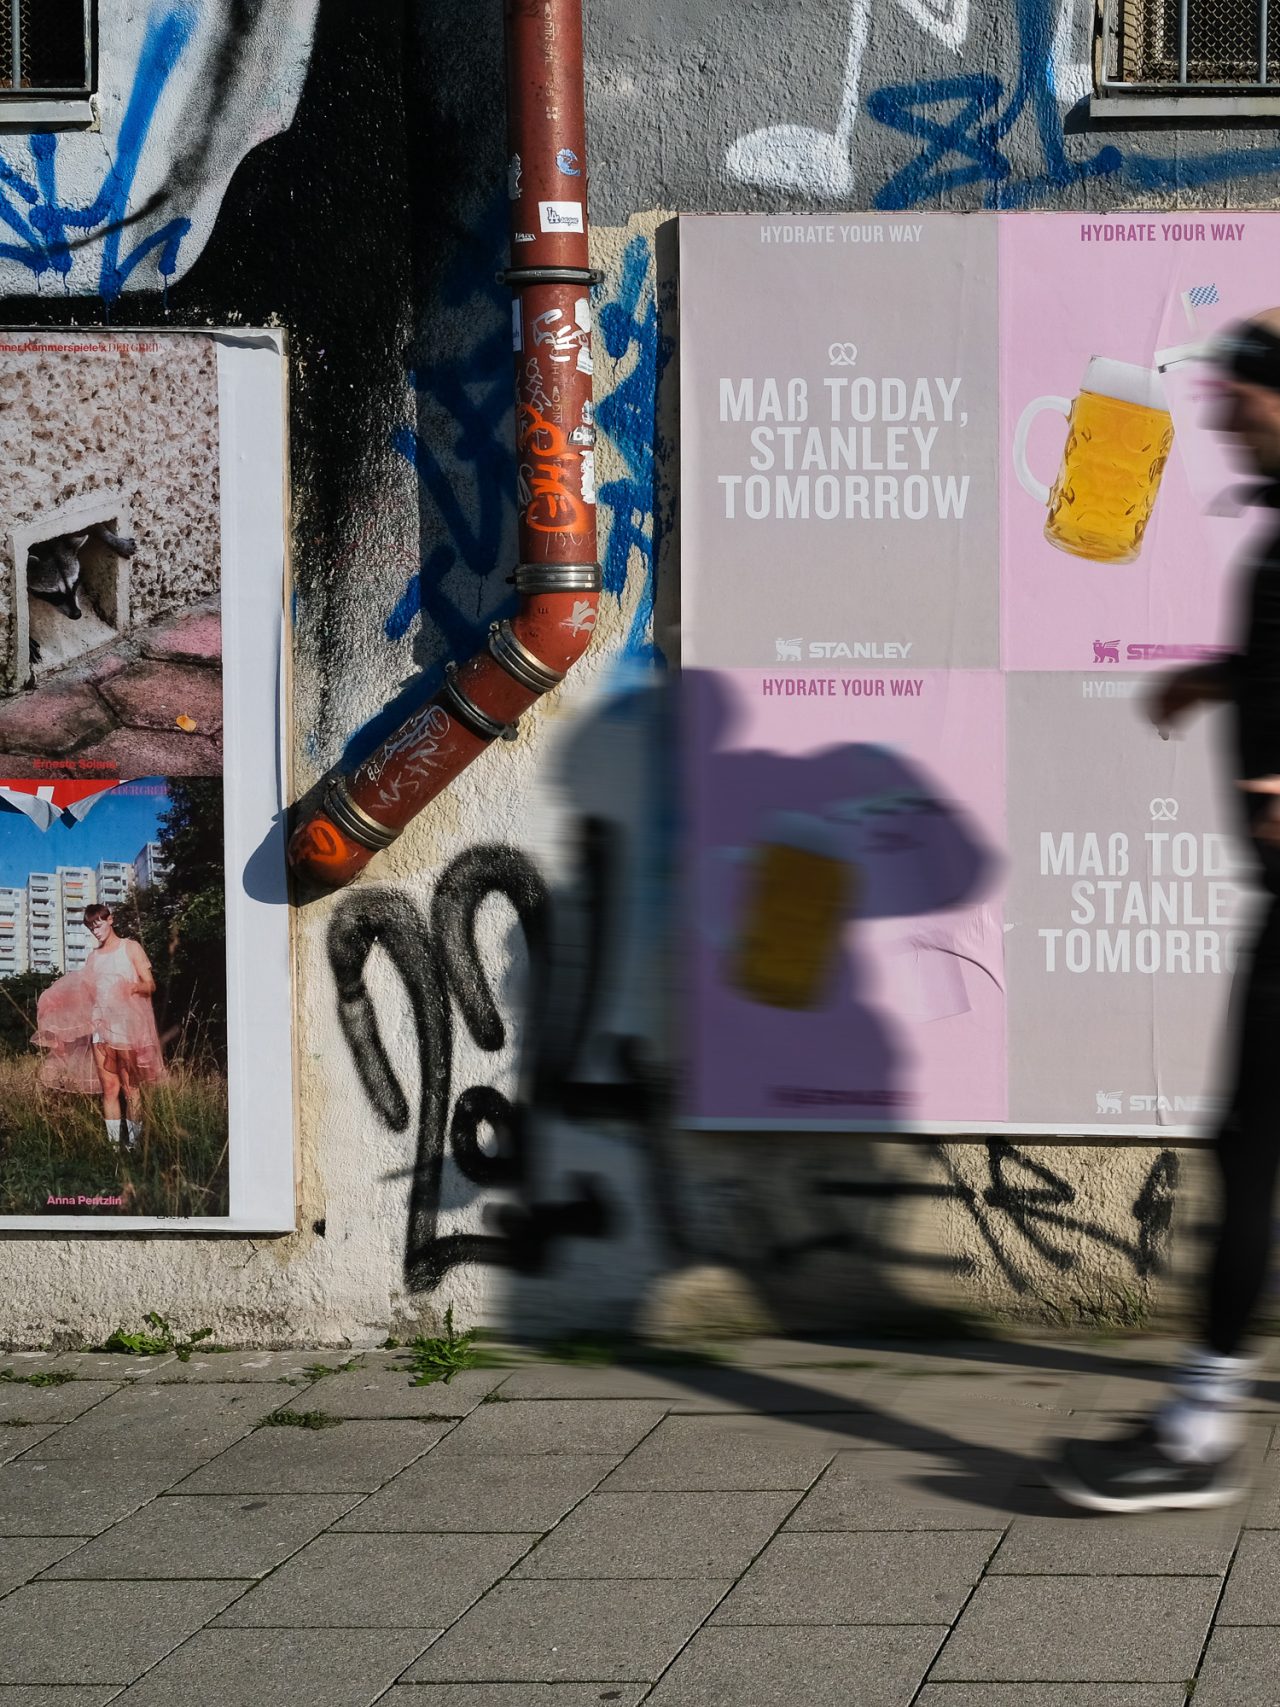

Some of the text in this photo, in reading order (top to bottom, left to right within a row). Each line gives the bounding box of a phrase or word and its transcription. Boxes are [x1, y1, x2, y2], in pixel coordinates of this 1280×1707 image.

[760, 224, 923, 243] HYDRATE YOUR WAY
[1080, 223, 1245, 242] HYDRATE YOUR WAY
[24, 342, 97, 354] Kammerspiele
[823, 377, 969, 428] TODAY,
[750, 426, 939, 471] STANLEY
[717, 475, 971, 520] TOMORROW
[808, 641, 913, 659] STANLEY
[762, 678, 924, 697] HYDRATE YOUR WAY
[1144, 832, 1238, 878] TOD
[1070, 880, 1245, 926] STANLE
[1038, 928, 1238, 975] TOMORR
[47, 1195, 76, 1206] Anna
